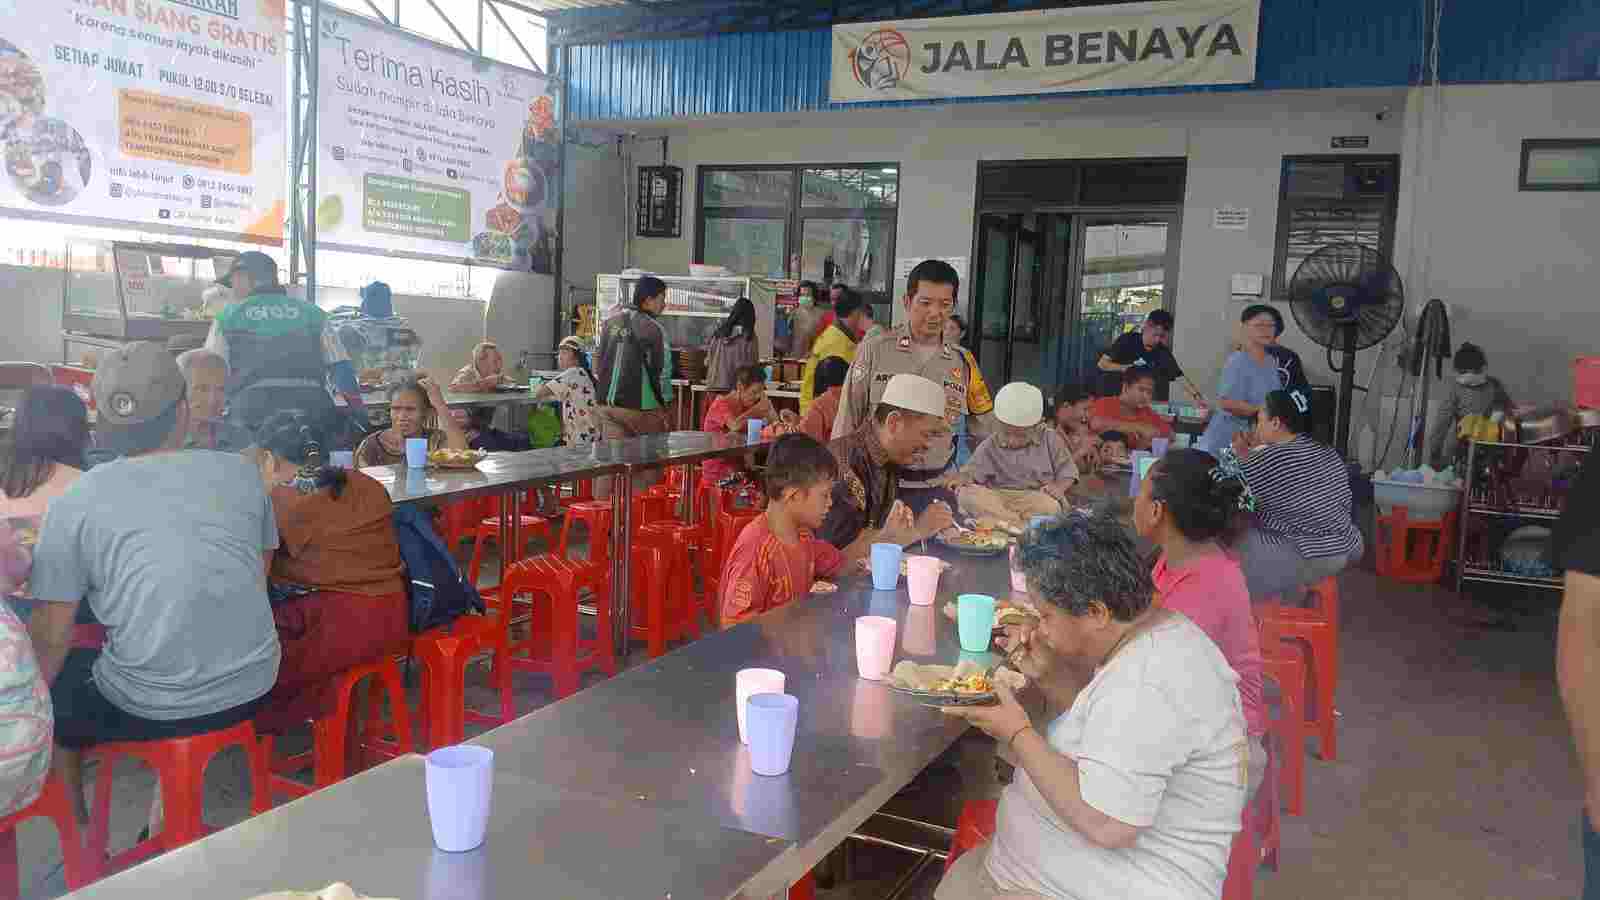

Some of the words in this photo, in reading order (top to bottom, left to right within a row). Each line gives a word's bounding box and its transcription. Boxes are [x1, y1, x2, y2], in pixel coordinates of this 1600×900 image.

[208, 20, 277, 56] GRATIS
[920, 37, 1029, 74] JALA
[1044, 24, 1241, 66] BENAYA
[54, 45, 101, 67] SETIAP
[104, 56, 144, 79] JUMAT
[336, 37, 424, 88] Terima
